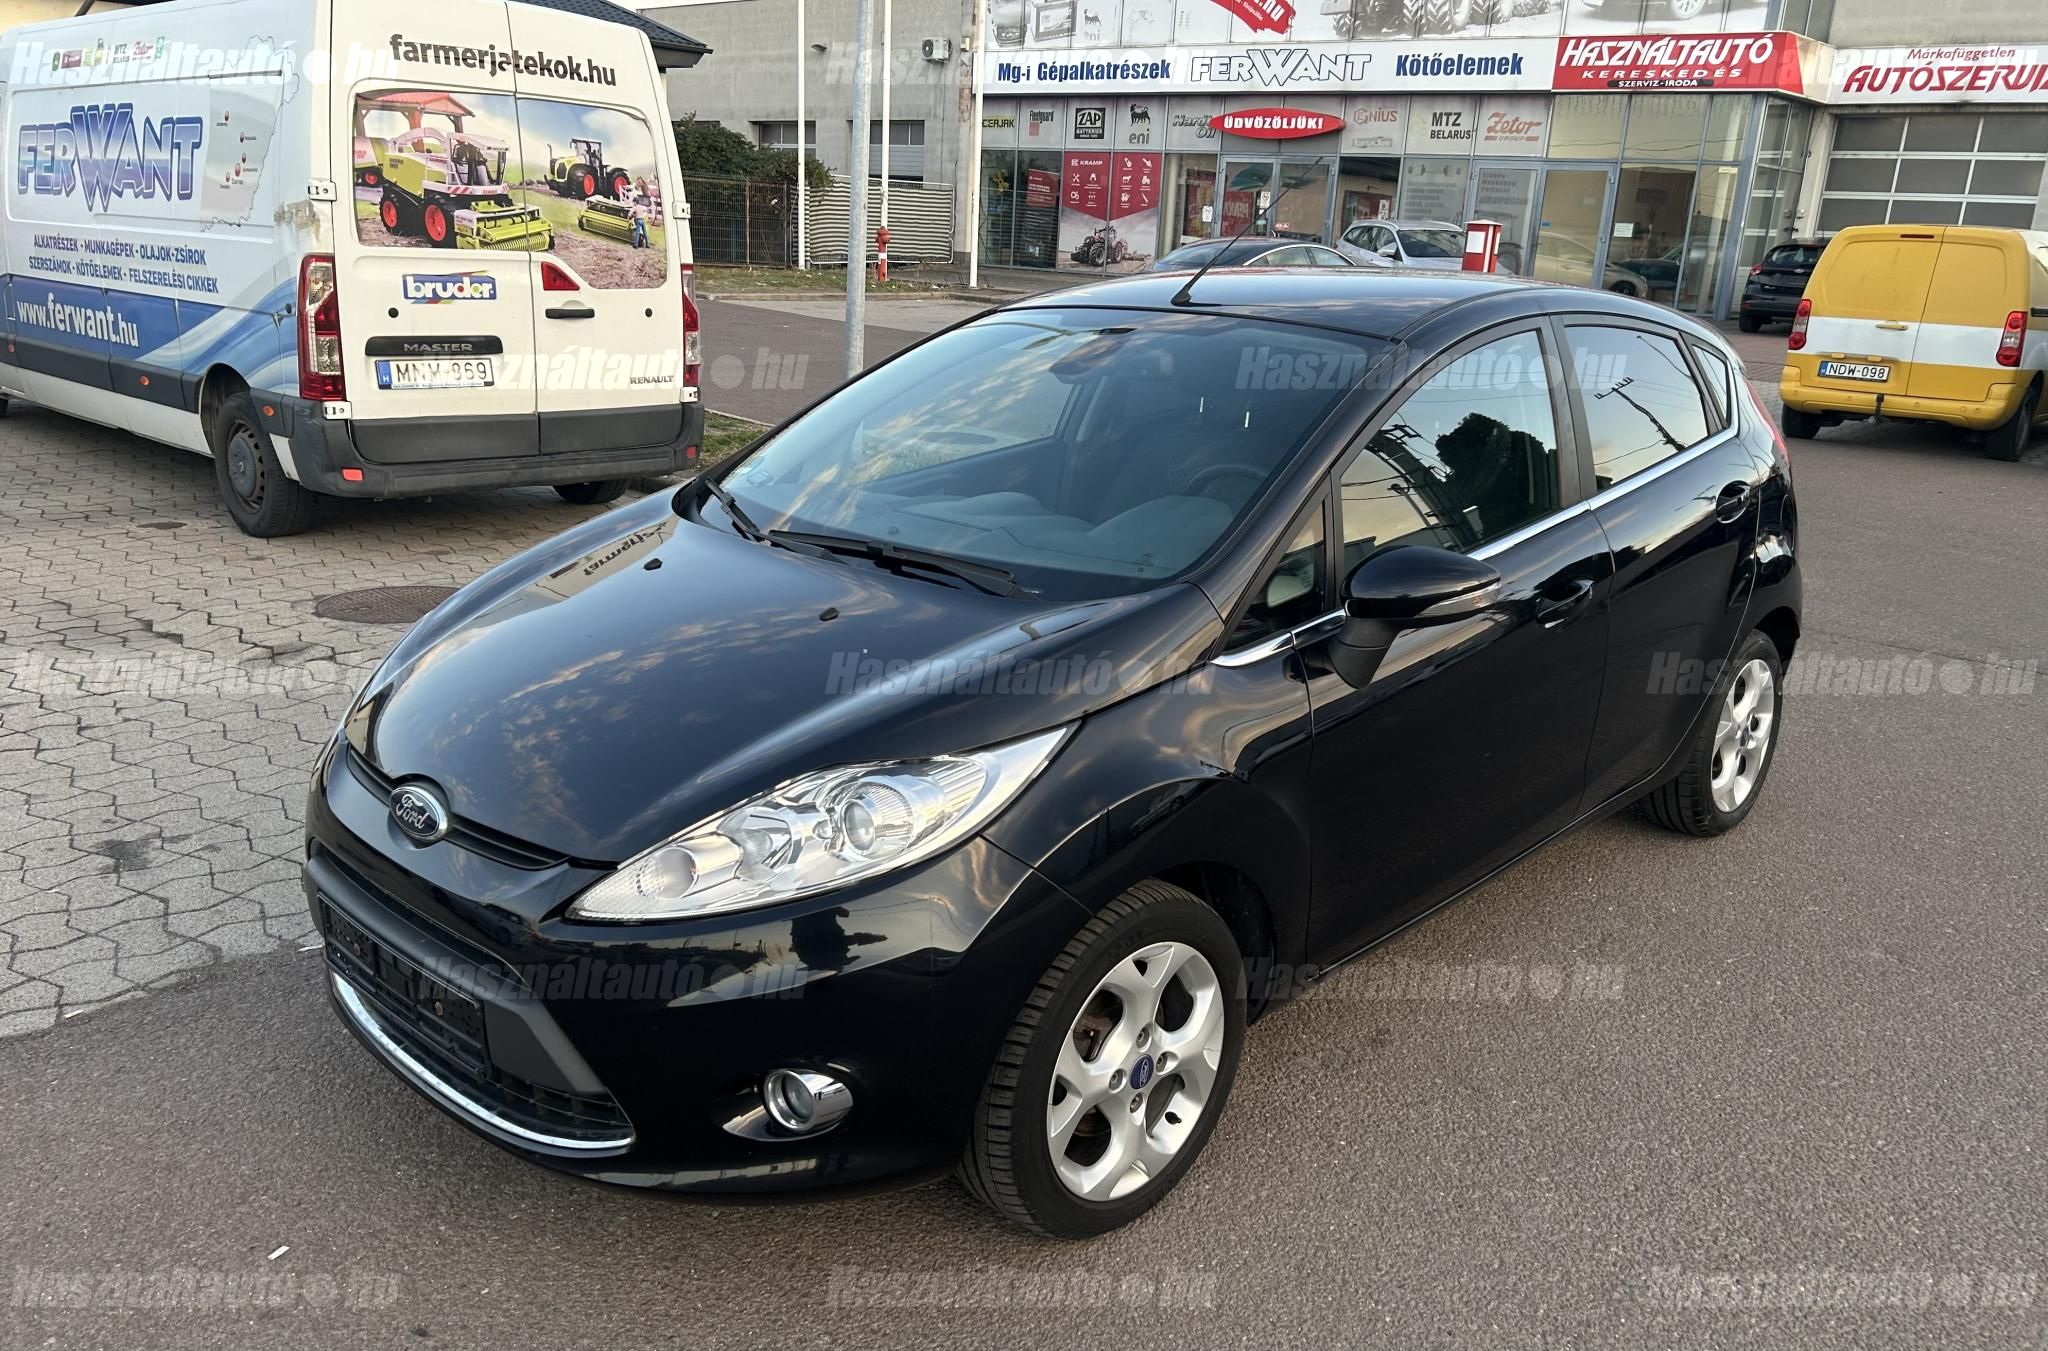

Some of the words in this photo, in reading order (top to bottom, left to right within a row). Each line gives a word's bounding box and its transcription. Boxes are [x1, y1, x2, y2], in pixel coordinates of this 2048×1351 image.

[389, 34, 617, 86] farmerjatekok.hu
[1560, 34, 1773, 68] HASZNÁLTAUTÓ
[1907, 47, 2016, 61] Márkafüggetlen
[998, 62, 1031, 83] Mg-i
[1037, 58, 1171, 82] Gépalkatrészek
[1191, 49, 1372, 86] FERWANT
[1396, 51, 1524, 77] Kötőelemek
[1582, 67, 1742, 79] KERESKEDÉS
[1618, 79, 1698, 88] SZERVIZ-IRODA
[1078, 111, 1101, 126] ZAP
[1223, 115, 1323, 129] ÜDVÖZÖLJÜK!
[1431, 112, 1462, 127] MTZ
[1487, 112, 1542, 134] Zetor
[1129, 128, 1150, 144] eni
[1430, 129, 1472, 140] BELARUS
[18, 102, 203, 212] FERWANT
[34, 233, 78, 252] ALKATRÉSZEK
[84, 238, 134, 258] MUNKAGÉPEK
[28, 255, 72, 274] SZERSZÁMOK
[129, 268, 187, 290] FELSZERELÉSI
[187, 276, 219, 294] CIKKEK
[405, 275, 493, 299] bruder
[17, 292, 139, 348] www.ferwant.hu
[404, 343, 473, 352] MASTER
[630, 375, 674, 385] RENAULT
[1829, 364, 1886, 379] NDW-098
[395, 793, 430, 829] Ford
